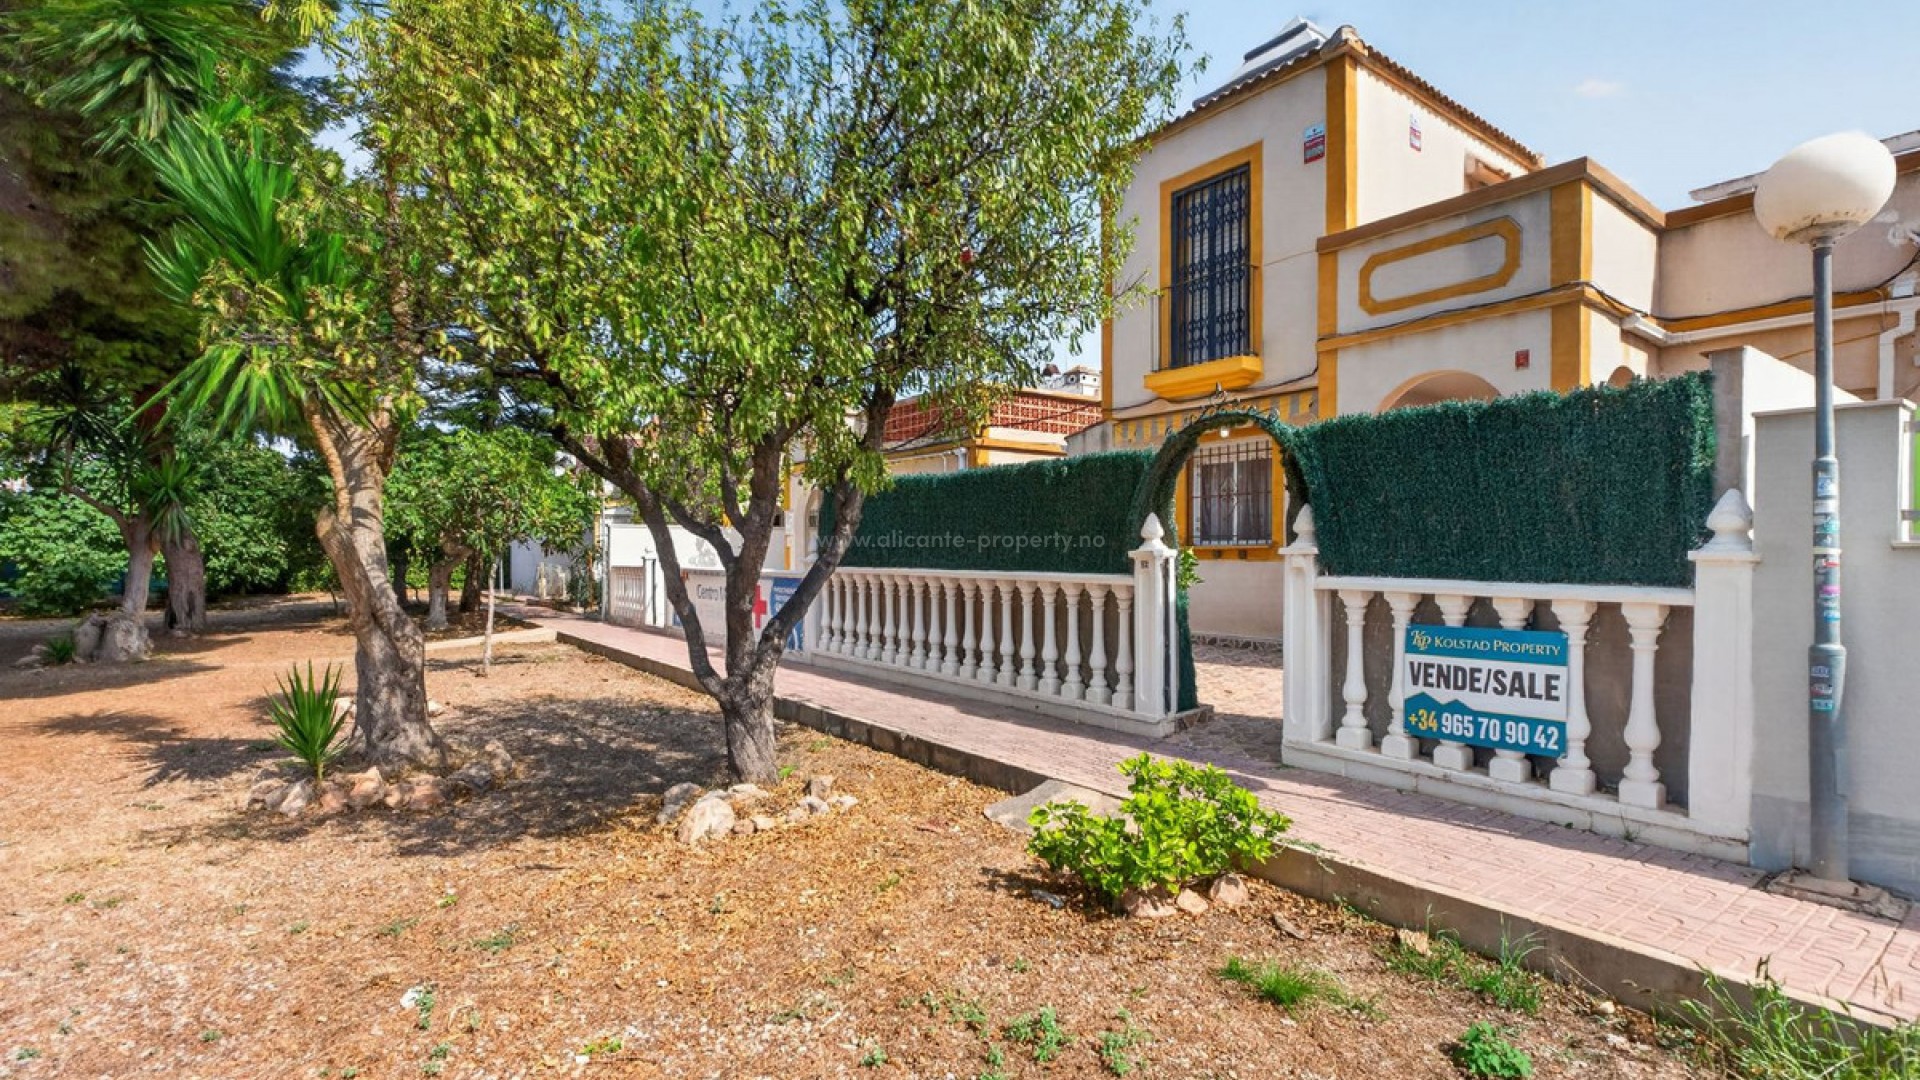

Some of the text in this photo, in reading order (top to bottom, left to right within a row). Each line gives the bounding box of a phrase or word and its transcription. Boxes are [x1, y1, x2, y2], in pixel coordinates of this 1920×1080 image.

[1434, 636, 1561, 656] KOLSTAD PROPERTY
[1409, 661, 1561, 701] VENDE/SALE
[1408, 709, 1559, 750] +34 965 70 90 42
